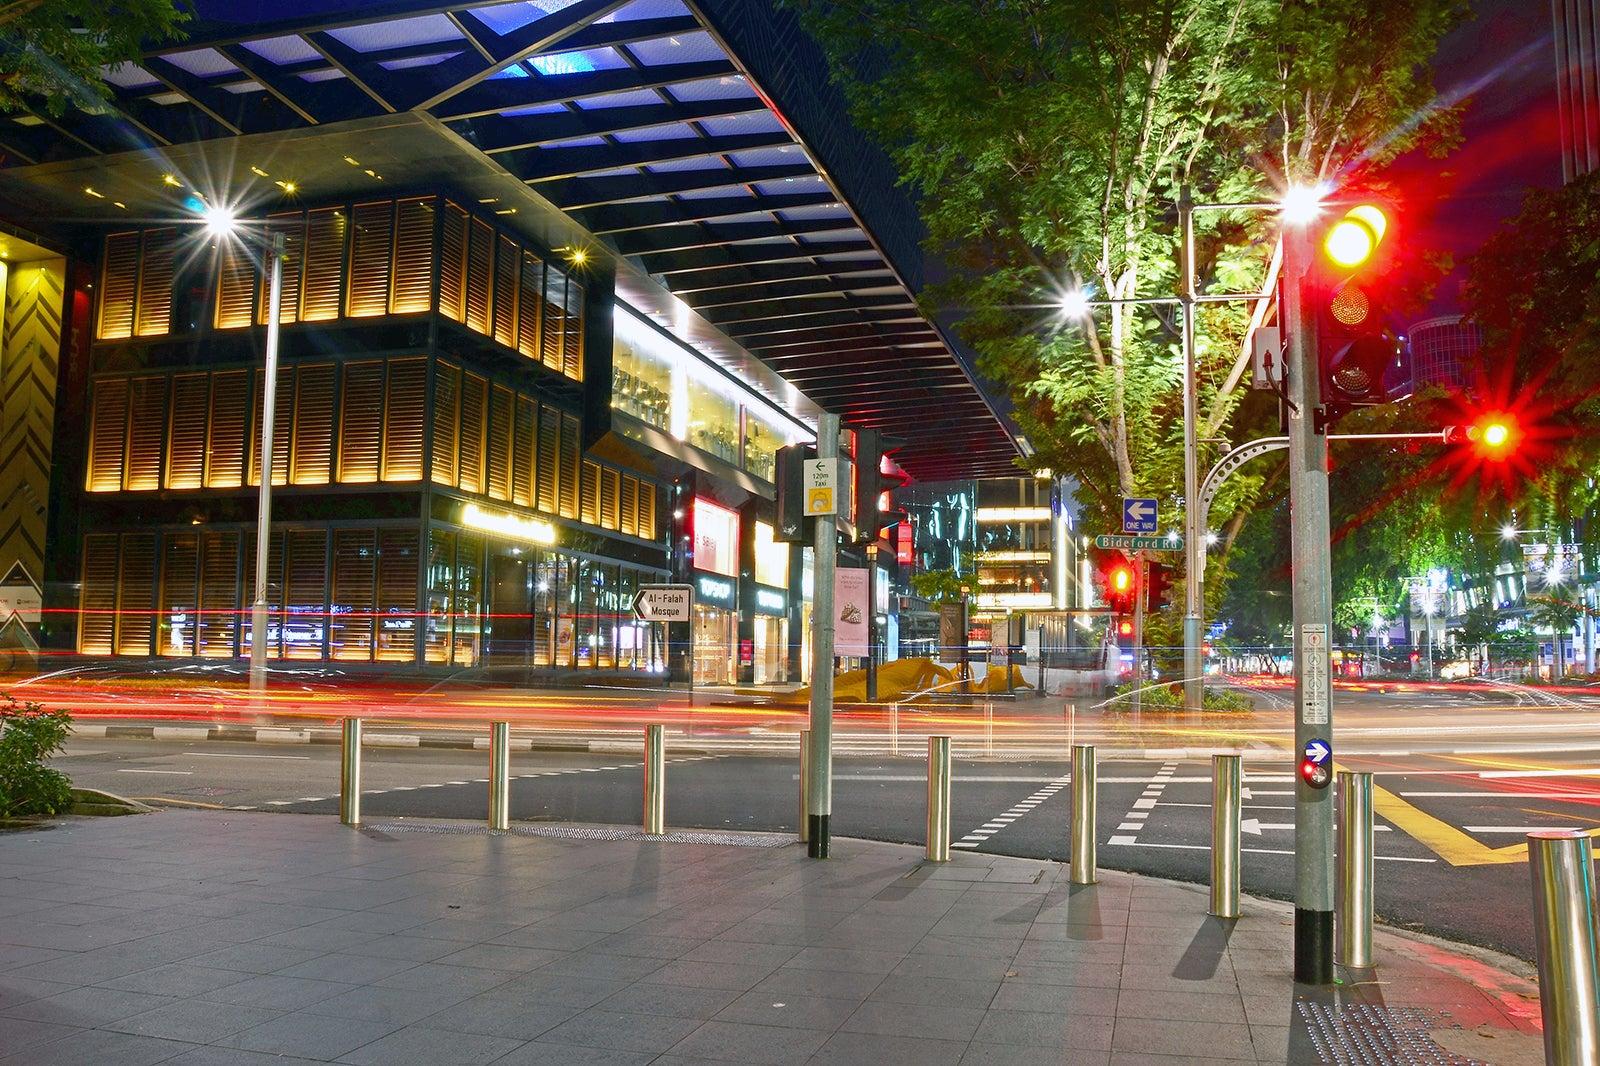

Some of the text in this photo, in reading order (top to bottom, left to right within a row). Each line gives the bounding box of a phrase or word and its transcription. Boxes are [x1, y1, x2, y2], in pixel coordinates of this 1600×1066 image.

[1126, 522, 1155, 530] ONE WAY
[1102, 537, 1177, 549] Bideford Rd
[651, 606, 680, 618] Mosque
